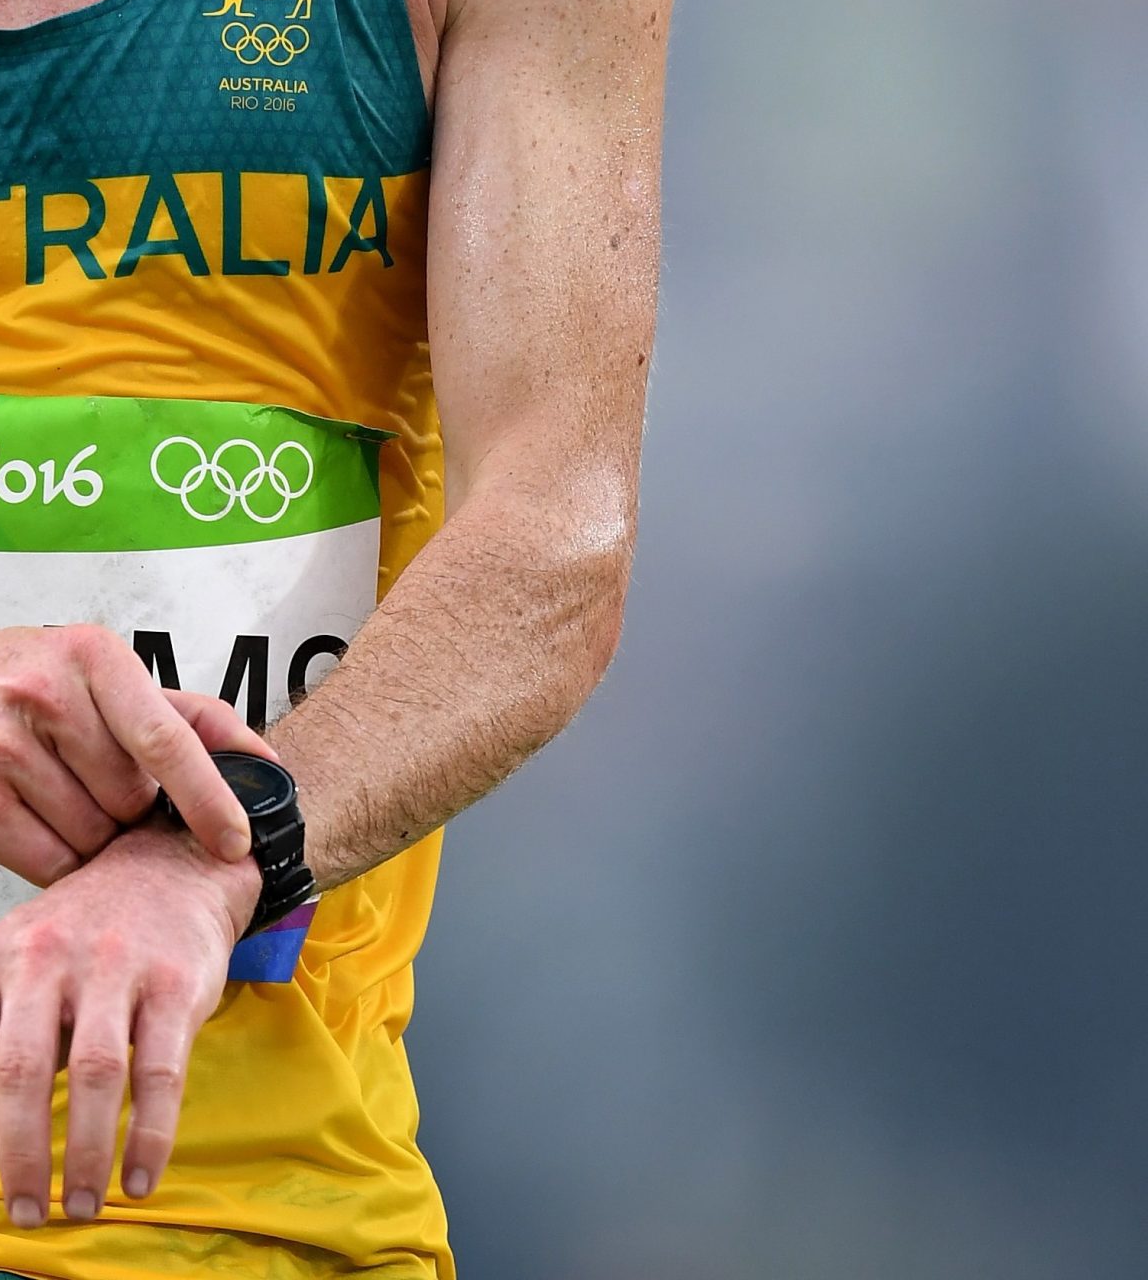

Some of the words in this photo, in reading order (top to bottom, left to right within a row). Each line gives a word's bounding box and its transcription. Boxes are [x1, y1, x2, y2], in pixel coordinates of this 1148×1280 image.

[219, 77, 309, 94] AUSTRALIA
[231, 95, 259, 110] RIO
[263, 96, 296, 112] 2016
